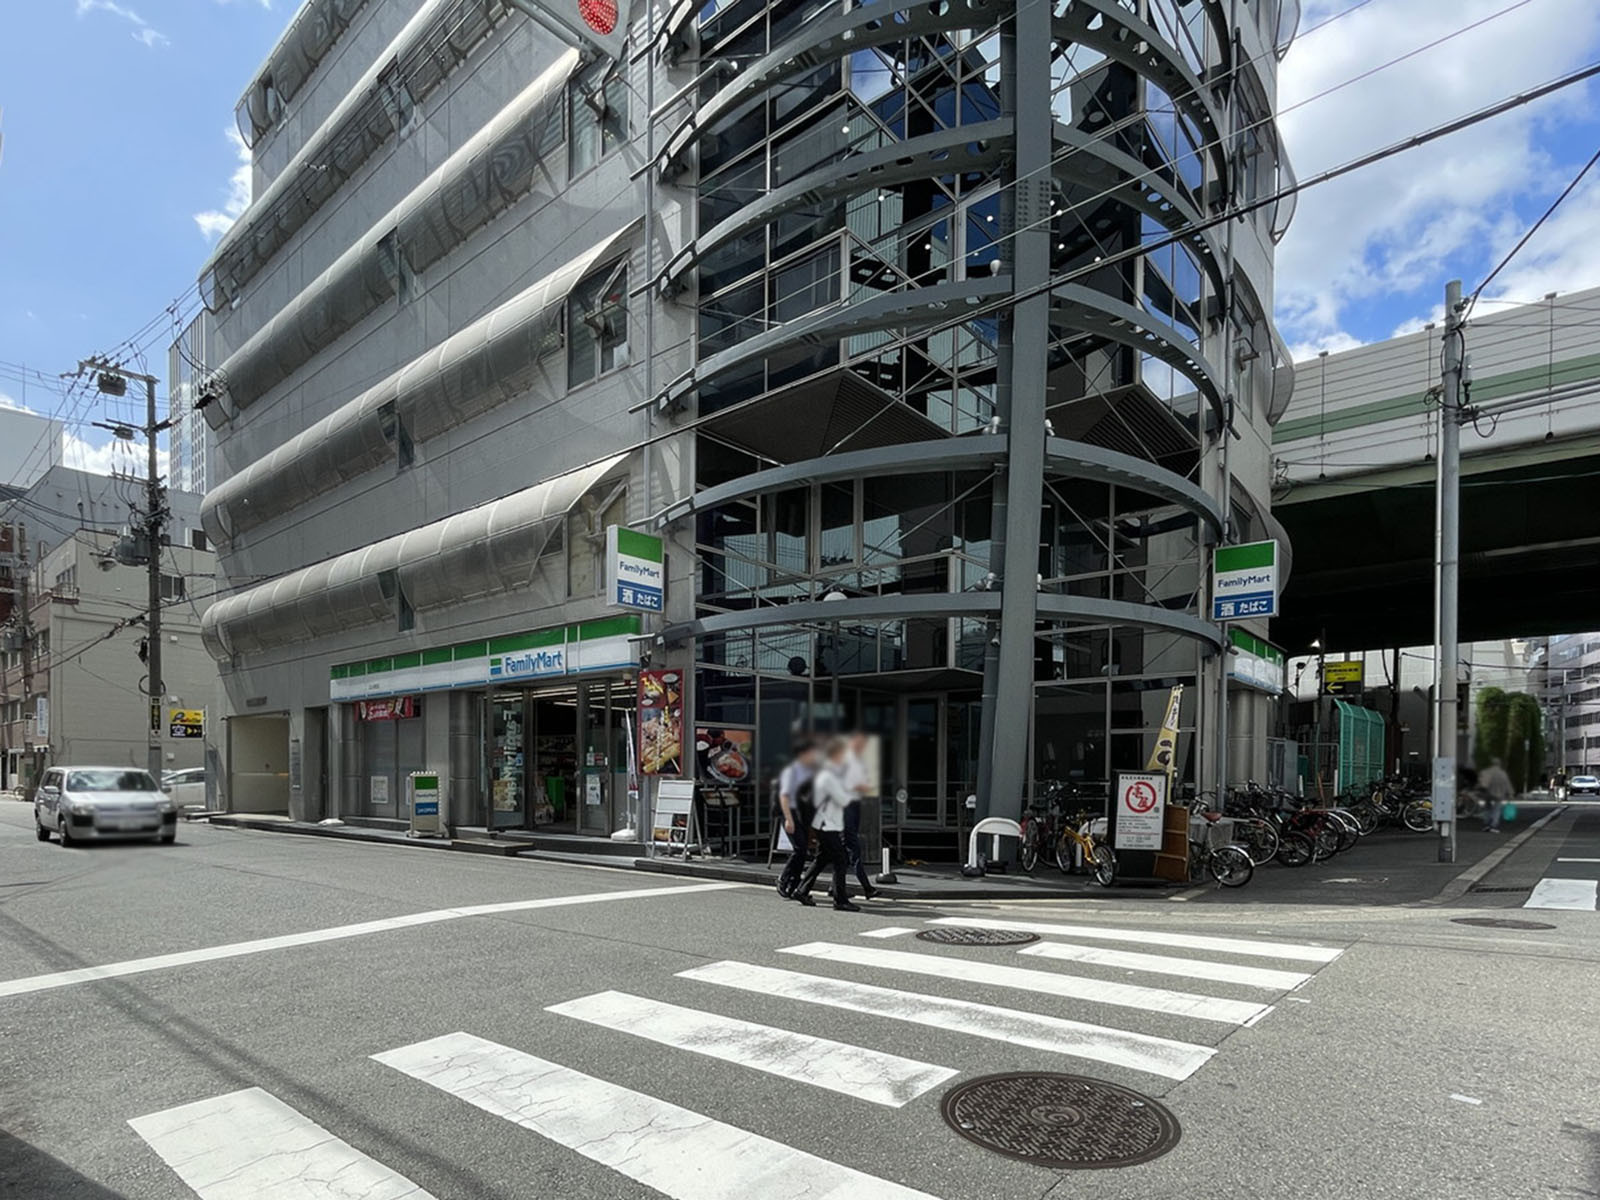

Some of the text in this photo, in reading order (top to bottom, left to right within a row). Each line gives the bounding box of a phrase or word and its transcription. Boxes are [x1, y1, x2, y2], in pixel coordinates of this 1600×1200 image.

[619, 561, 660, 580] FamilyMart
[1217, 574, 1271, 588] FamilyMart
[622, 588, 659, 607] 酒 たばこ
[1220, 600, 1268, 616] 酒 たばこ
[505, 651, 562, 673] FamilyMart
